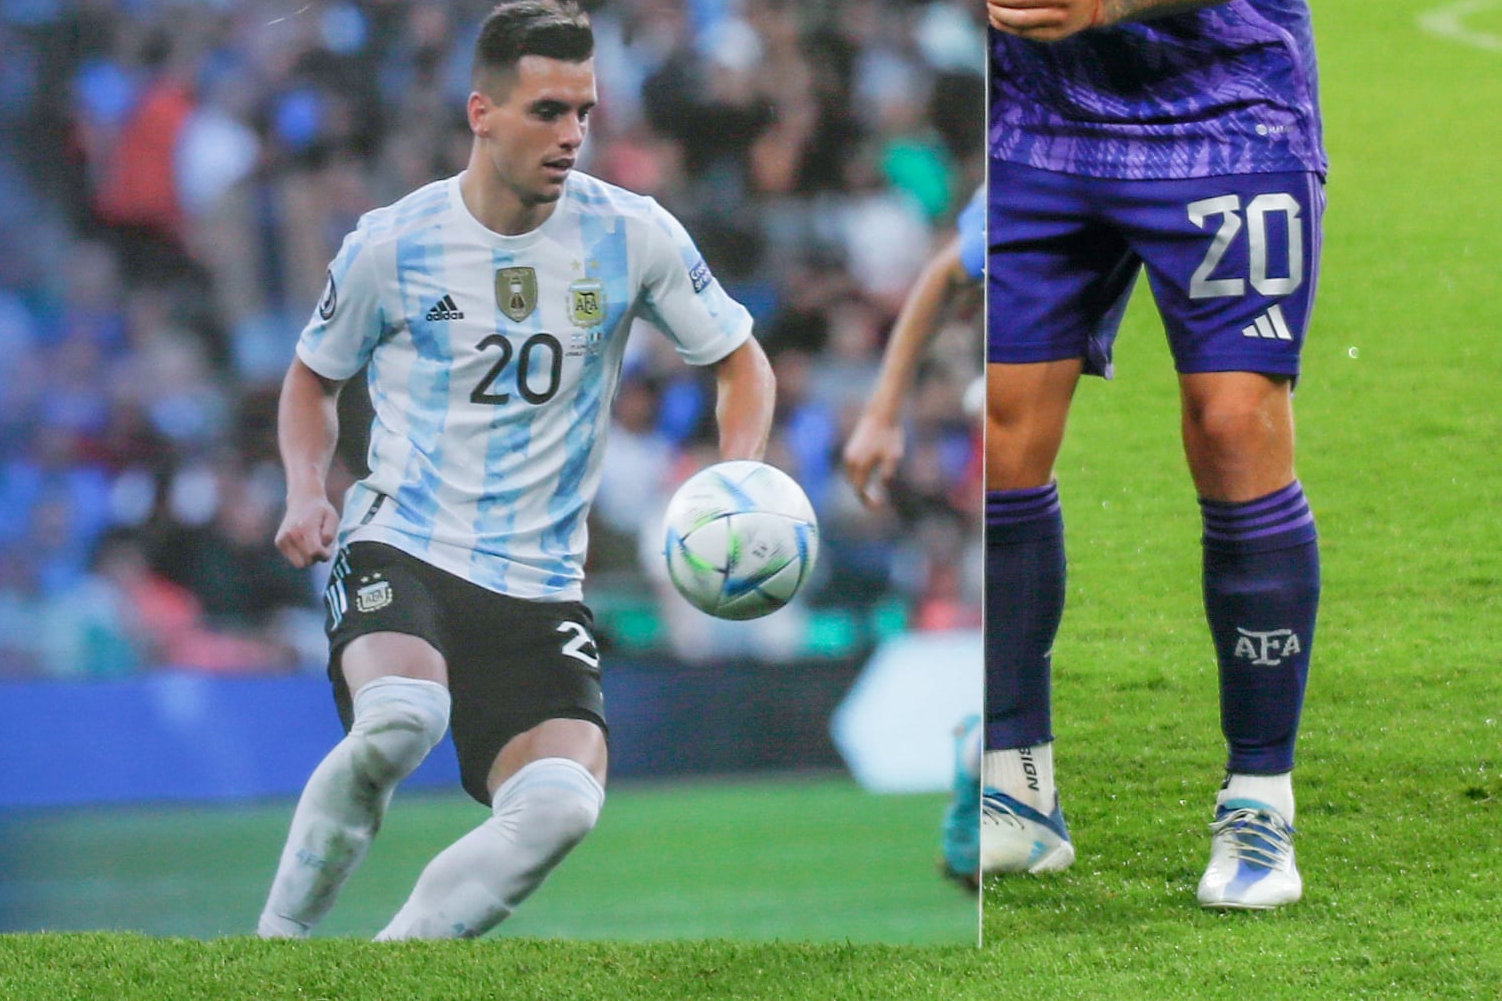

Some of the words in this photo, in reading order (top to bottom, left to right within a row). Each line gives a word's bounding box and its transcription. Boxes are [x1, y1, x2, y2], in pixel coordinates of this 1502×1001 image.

[1187, 193, 1303, 299] 20
[425, 309, 465, 322] adidas
[574, 292, 599, 316] AFA
[469, 332, 564, 406] 20
[1233, 626, 1302, 666] AFA
